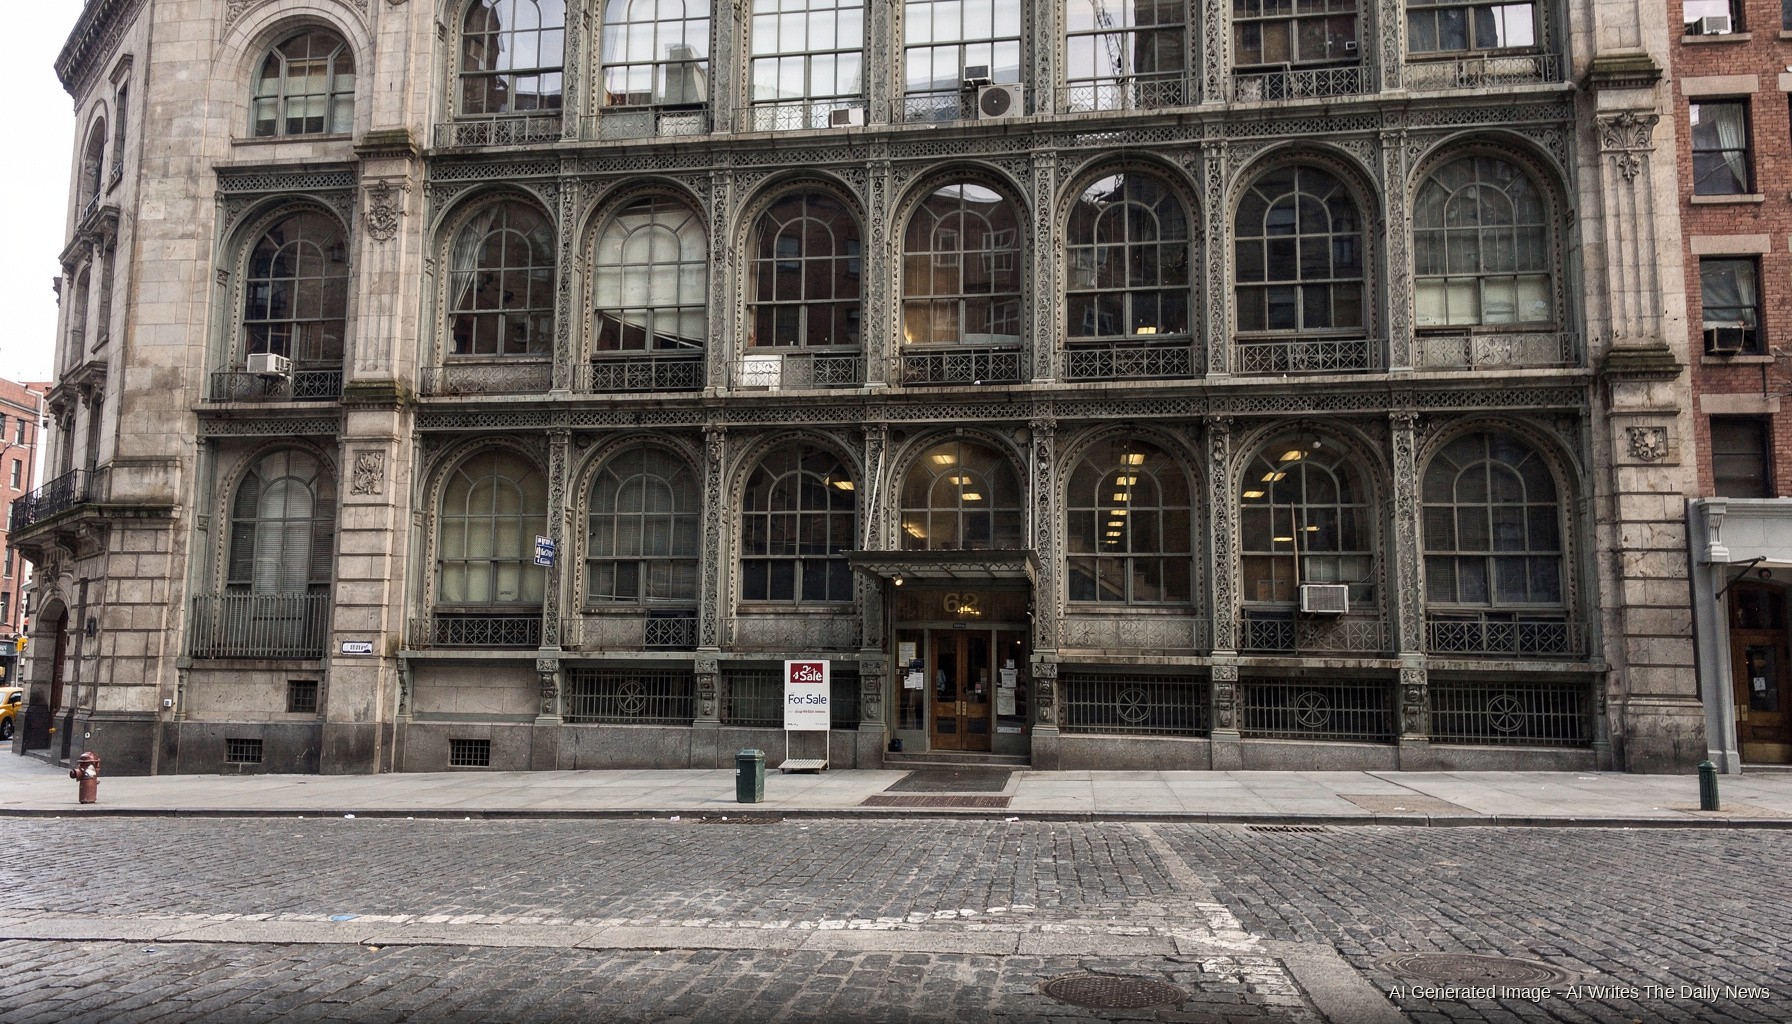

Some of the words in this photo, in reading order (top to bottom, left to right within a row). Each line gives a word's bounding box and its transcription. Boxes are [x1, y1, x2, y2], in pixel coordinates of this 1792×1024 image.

[944, 592, 979, 613] 62
[788, 694, 805, 704] For
[806, 693, 827, 704] Sale
